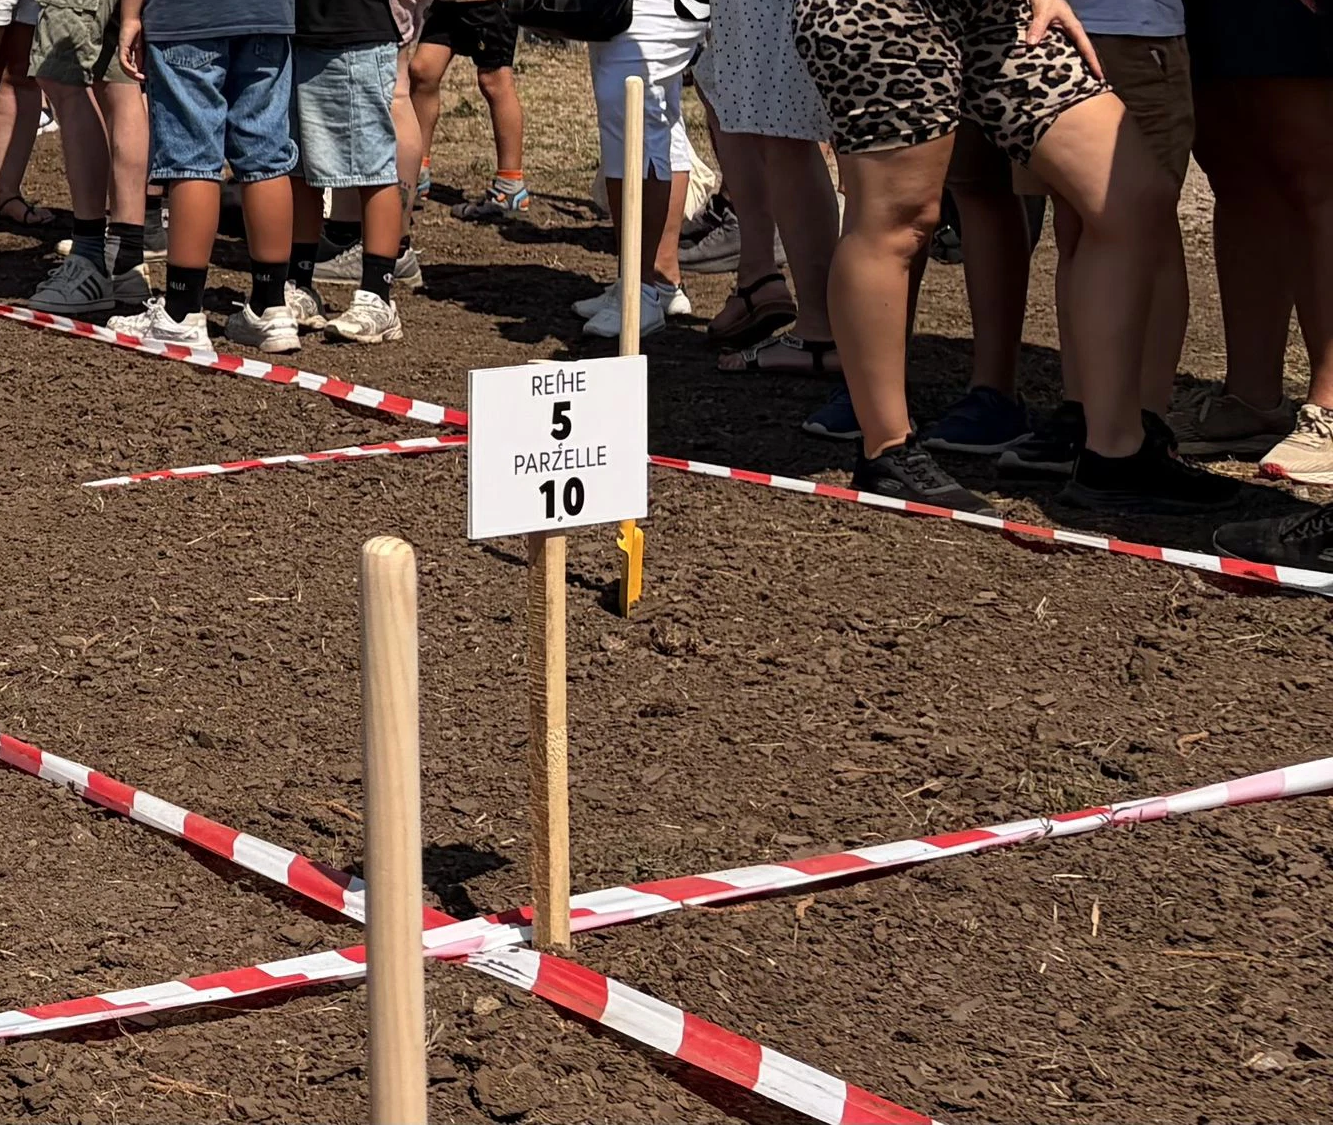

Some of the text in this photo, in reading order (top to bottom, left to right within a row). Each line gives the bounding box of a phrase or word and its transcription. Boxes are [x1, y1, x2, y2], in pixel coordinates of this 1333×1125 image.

[532, 371, 587, 396] REIHE
[550, 400, 572, 441] 5
[515, 445, 608, 475] PARZELLE
[539, 477, 585, 519] 10
